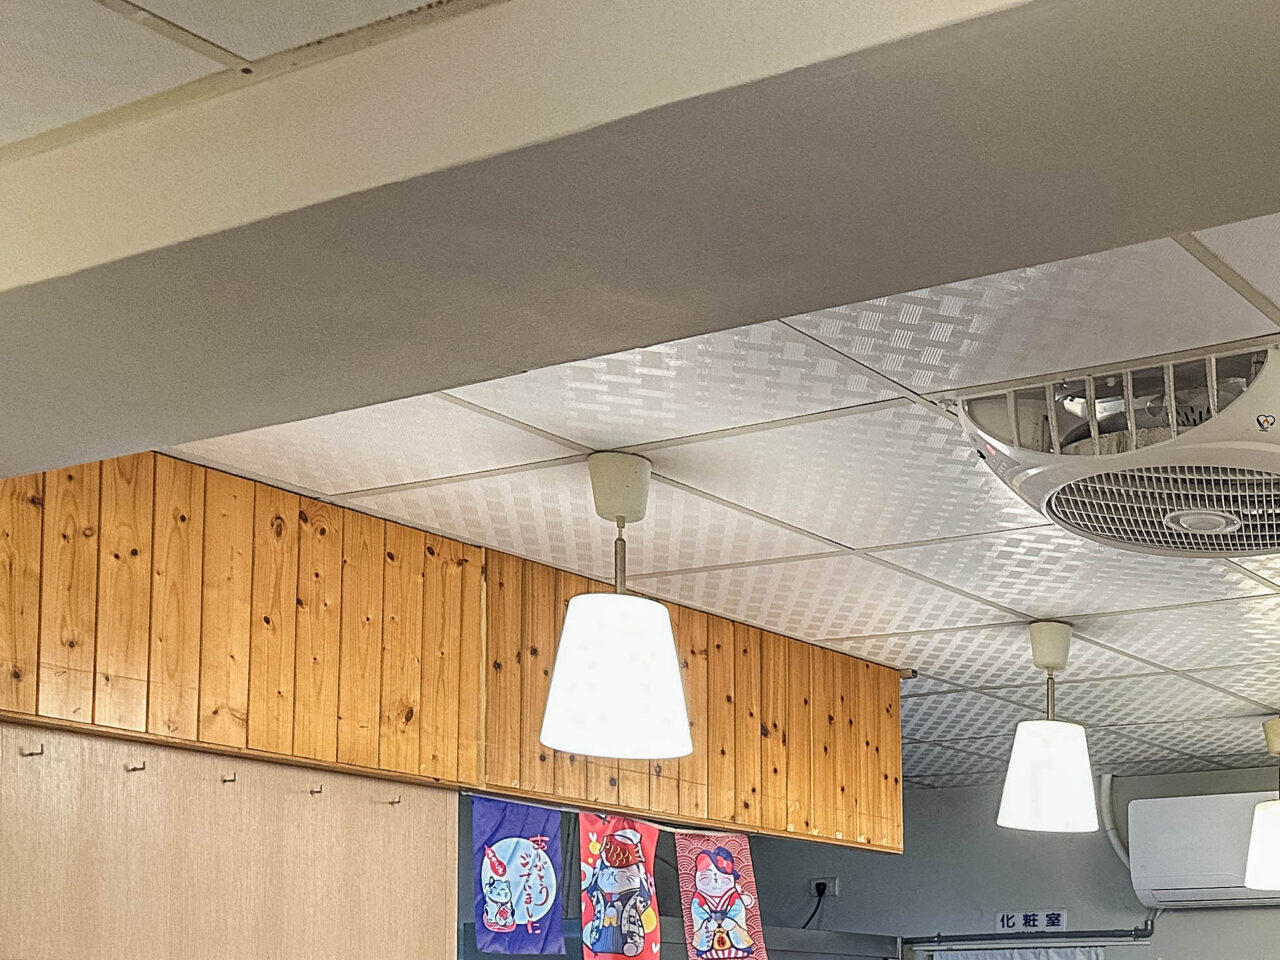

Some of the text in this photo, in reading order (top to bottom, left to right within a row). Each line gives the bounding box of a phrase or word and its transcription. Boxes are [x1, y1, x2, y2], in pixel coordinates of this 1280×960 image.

[528, 834, 550, 907] ありがとう
[1000, 912, 1062, 928] 化粧室
